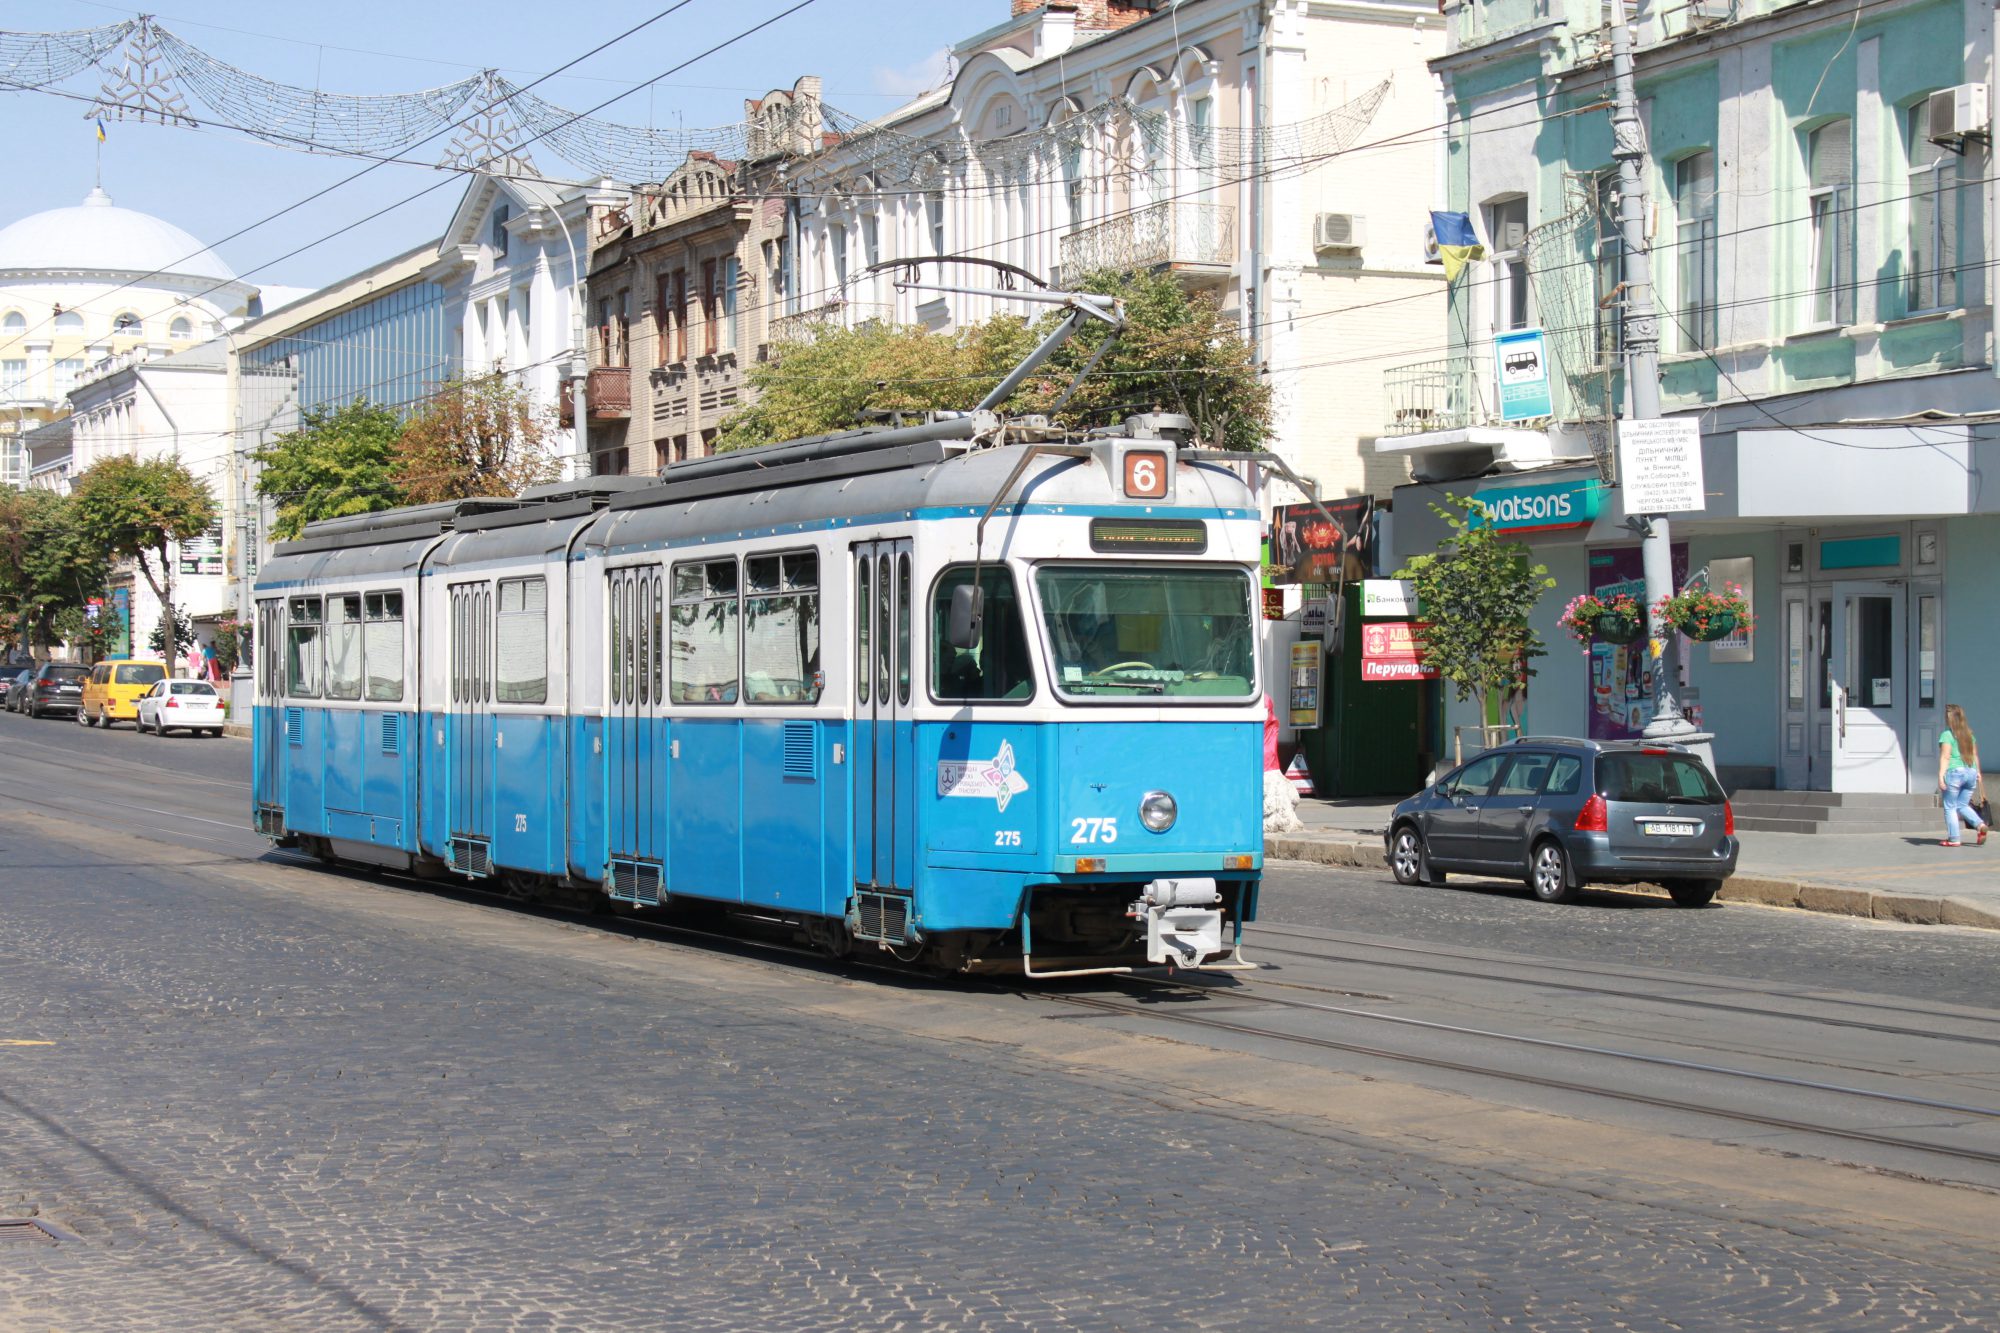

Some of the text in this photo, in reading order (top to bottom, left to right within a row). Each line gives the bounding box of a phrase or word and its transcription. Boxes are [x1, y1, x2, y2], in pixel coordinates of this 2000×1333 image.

[1133, 459, 1156, 492] 6
[1483, 493, 1571, 522] watsons
[1376, 595, 1415, 604] Банкомат
[515, 813, 527, 833] 275
[1070, 817, 1118, 844] 275
[994, 830, 1021, 846] 275
